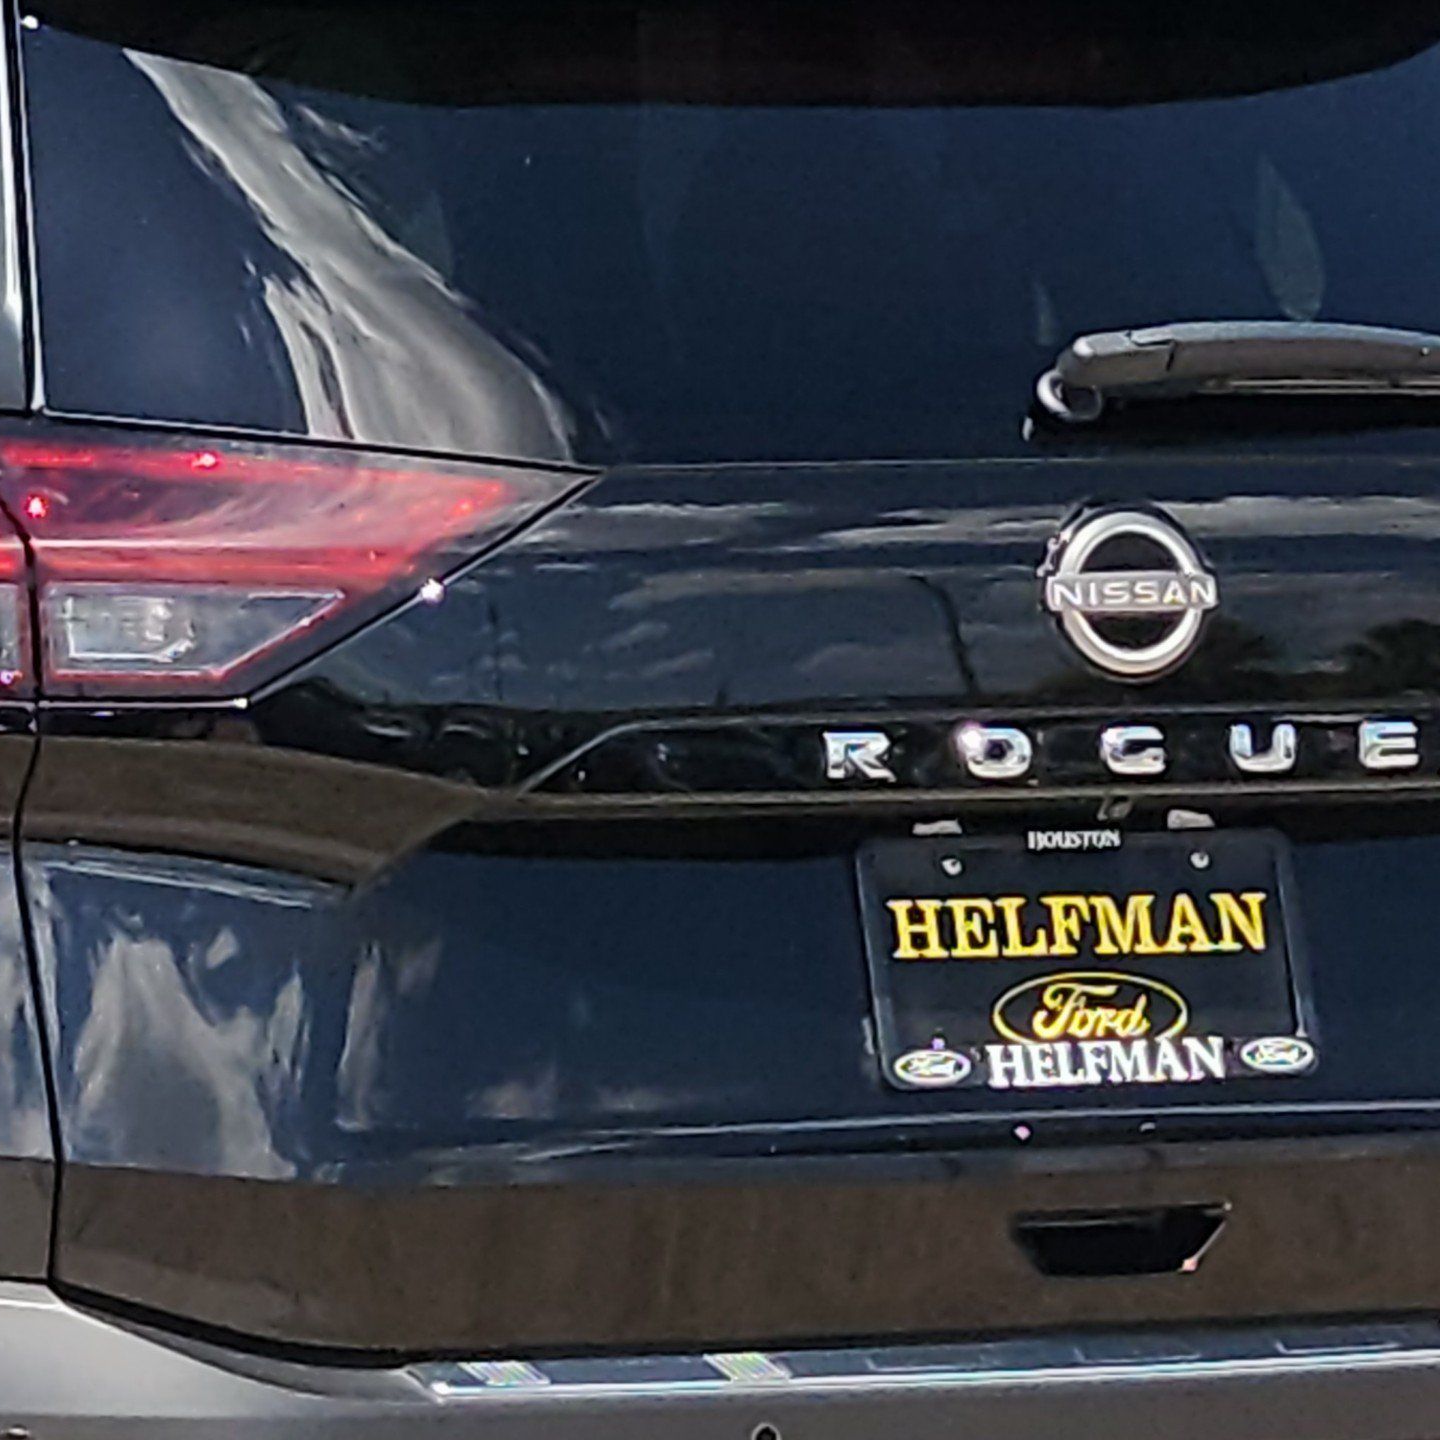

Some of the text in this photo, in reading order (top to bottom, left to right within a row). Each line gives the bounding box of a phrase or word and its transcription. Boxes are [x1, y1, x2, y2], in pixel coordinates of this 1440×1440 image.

[1052, 579, 1213, 607] NISSAN
[822, 721, 1420, 782] ROGUE
[886, 892, 1267, 959] HELFMAN
[1032, 981, 1151, 1040] Ford
[983, 1035, 1226, 1088] HELFMAN
